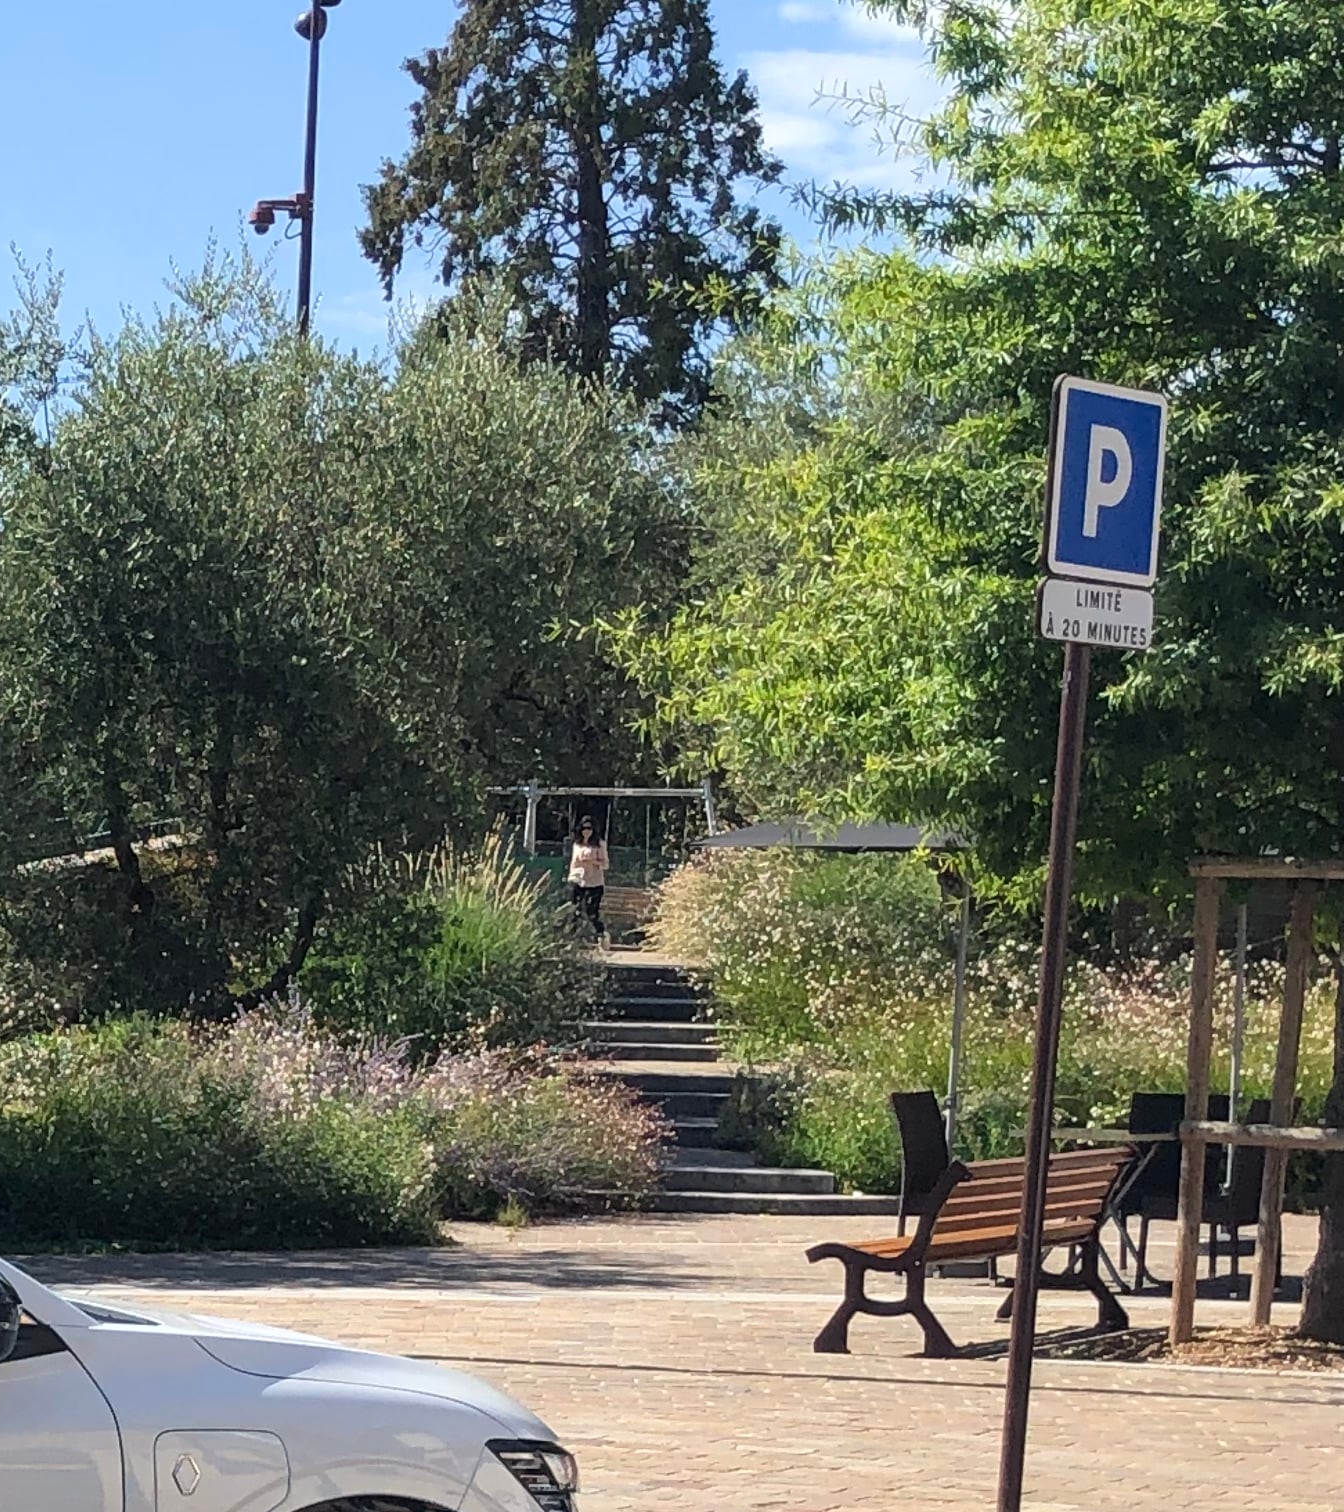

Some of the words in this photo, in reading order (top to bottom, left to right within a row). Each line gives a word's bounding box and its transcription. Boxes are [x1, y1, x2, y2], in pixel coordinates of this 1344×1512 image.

[1082, 423, 1132, 538] P
[1076, 588, 1122, 613] LIMITÉ
[1062, 619, 1080, 639] 20
[1087, 620, 1147, 647] MINUTES
